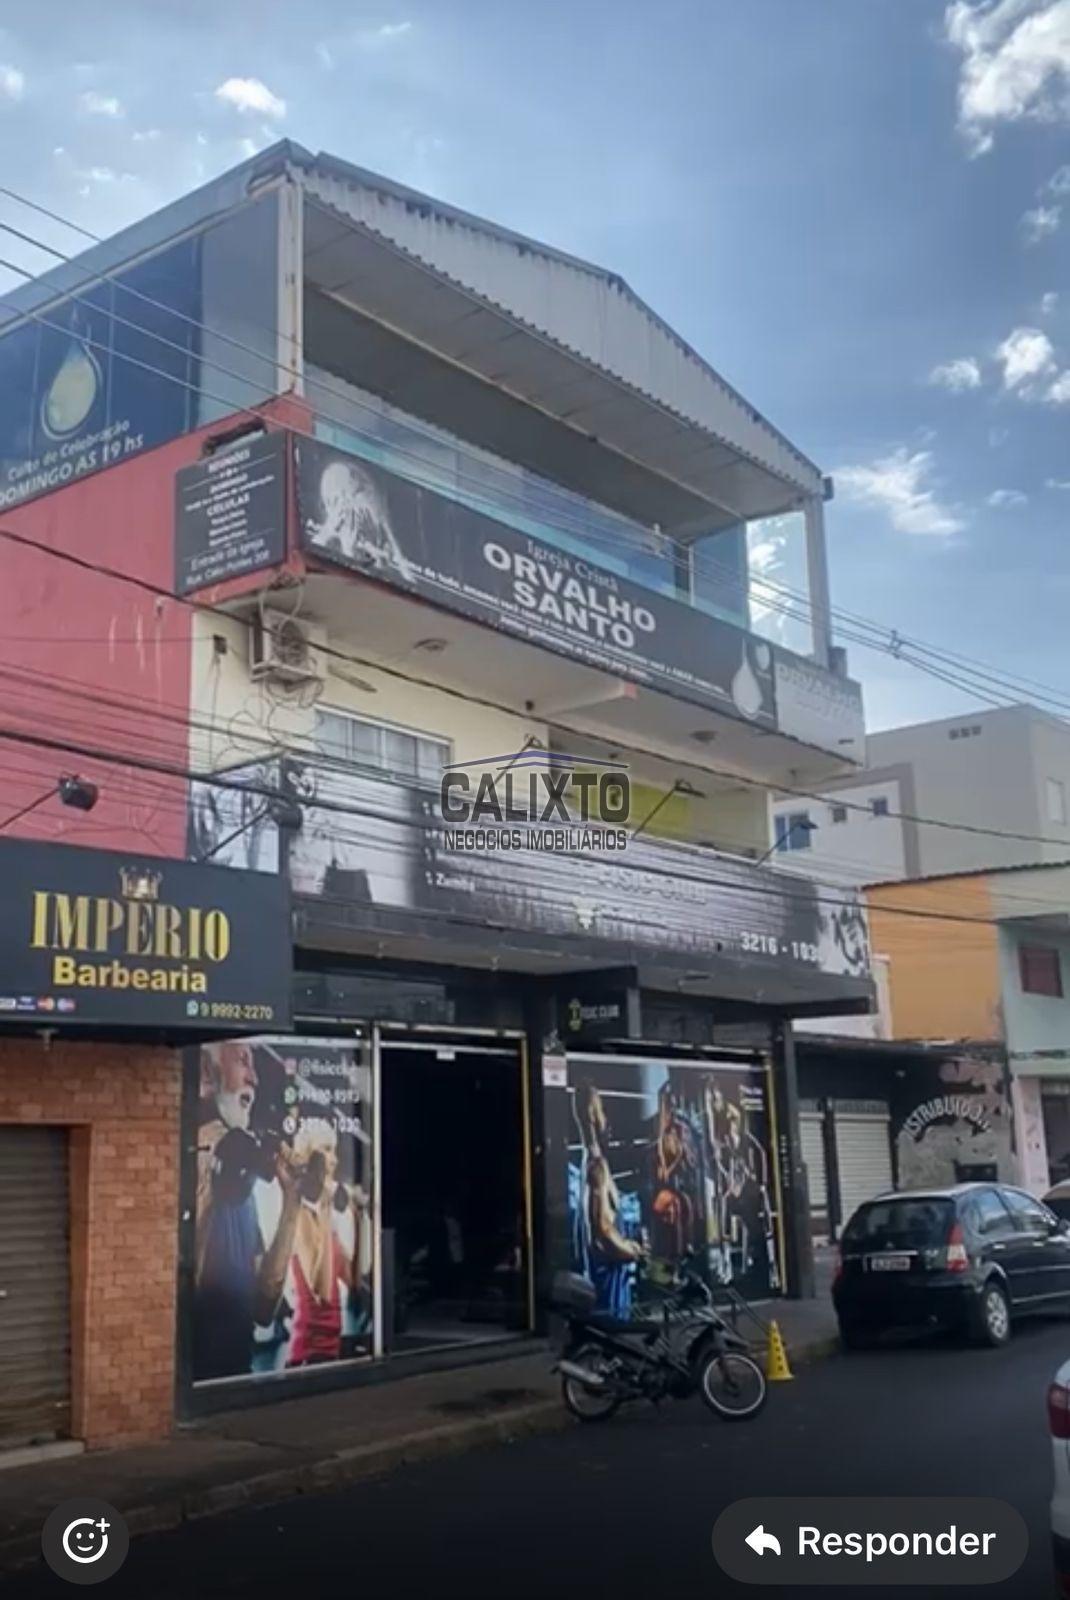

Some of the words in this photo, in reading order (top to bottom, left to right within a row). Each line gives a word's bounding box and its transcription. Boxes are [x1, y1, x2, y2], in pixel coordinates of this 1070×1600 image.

[102, 440, 121, 462] 19
[526, 540, 570, 573] Igreja
[483, 542, 656, 632] ORVALHO
[513, 580, 635, 648] SANTO
[54, 955, 208, 994] Barbearia
